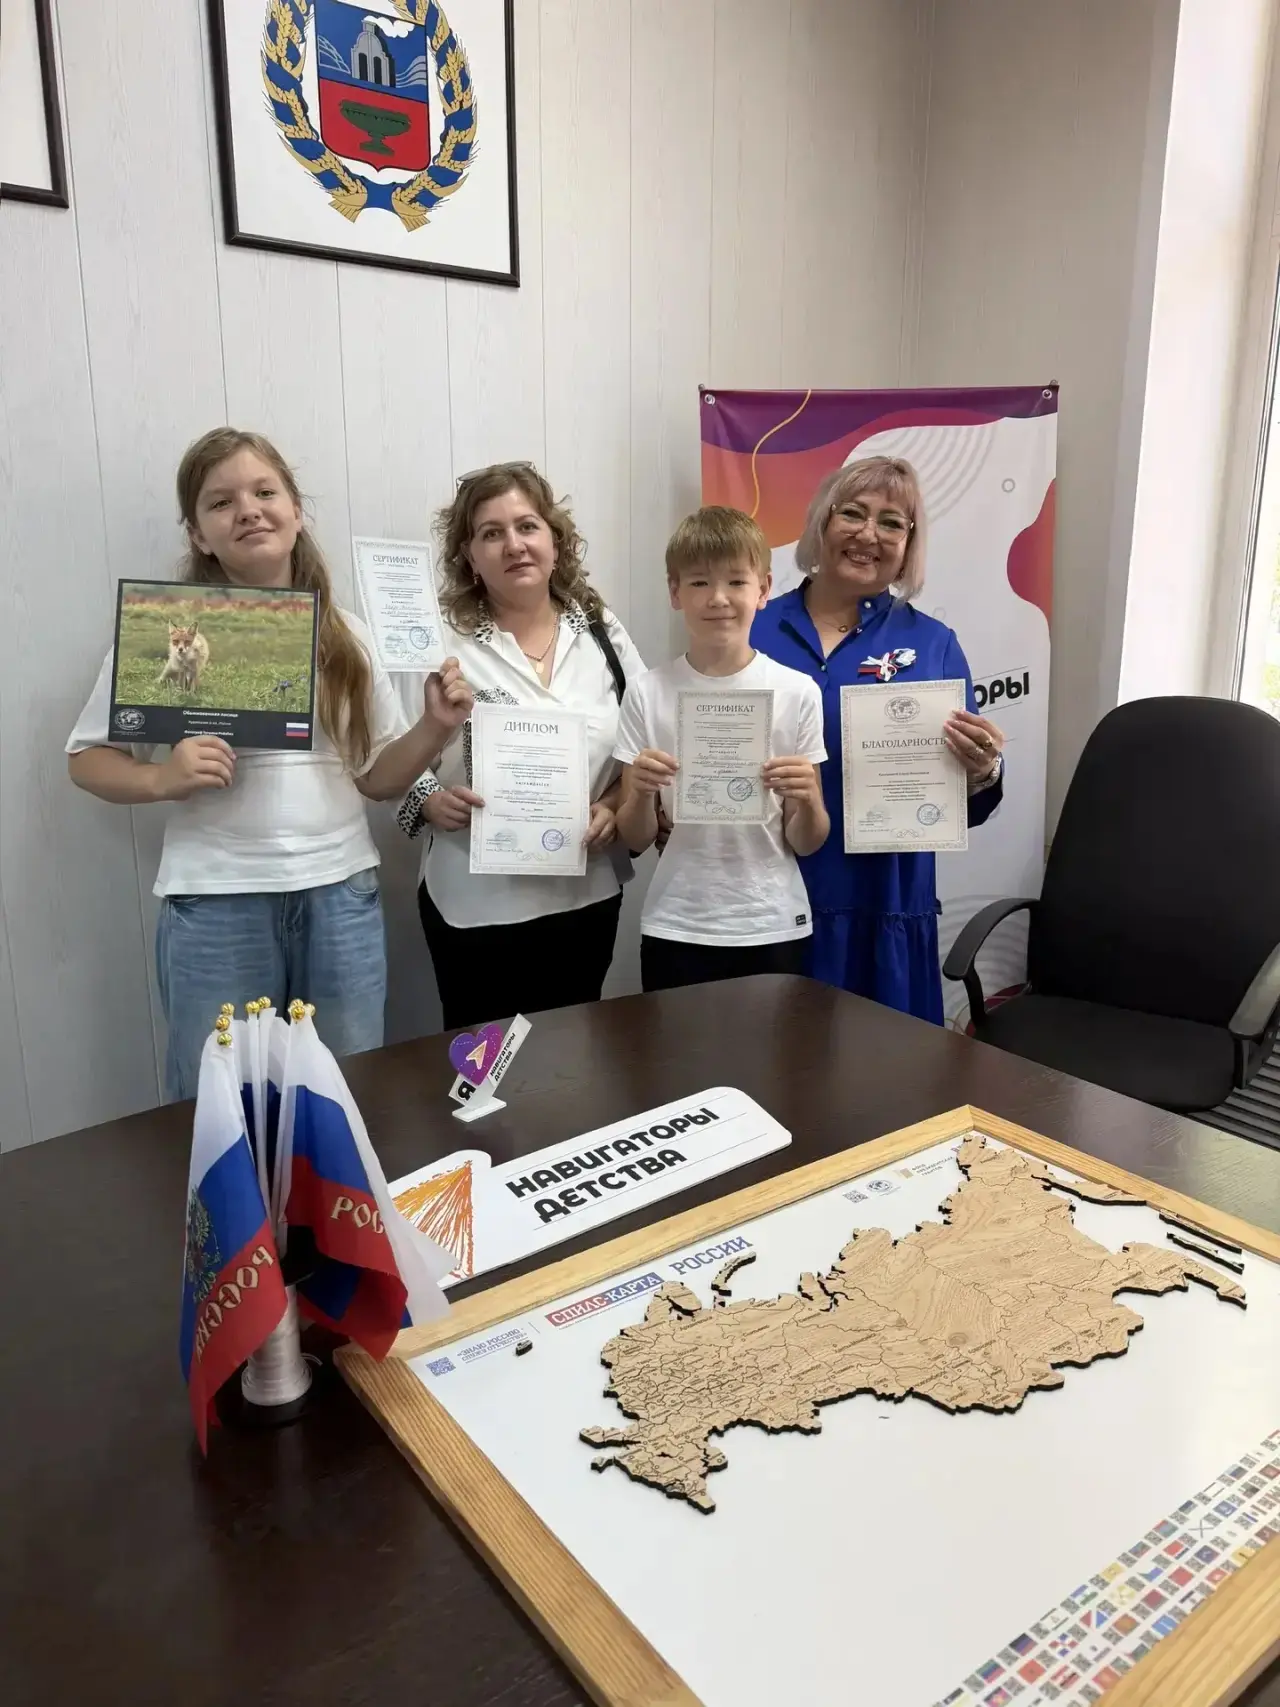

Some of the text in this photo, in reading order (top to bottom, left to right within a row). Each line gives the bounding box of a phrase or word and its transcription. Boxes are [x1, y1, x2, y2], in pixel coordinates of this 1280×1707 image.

[373, 555, 419, 565] СЕРТИФИКАТ
[696, 704, 756, 713] СЕРТИФИКАТ
[504, 721, 559, 735] ДИПЛОМ
[862, 737, 947, 749] БЛАГОДАРНОСТЬ
[490, 1033, 516, 1077] НАВИГАТОРЫ
[494, 1051, 513, 1082] ДЕТСТВА
[457, 1080, 477, 1101] Я
[505, 1107, 720, 1198] НАВИГАТОРЫ
[533, 1148, 688, 1224] ДЕТСТВА
[550, 1273, 659, 1327] СПИЛС-КАРТА
[669, 1236, 753, 1276] РОССИИ
[487, 1328, 521, 1346] РОССИЮ
